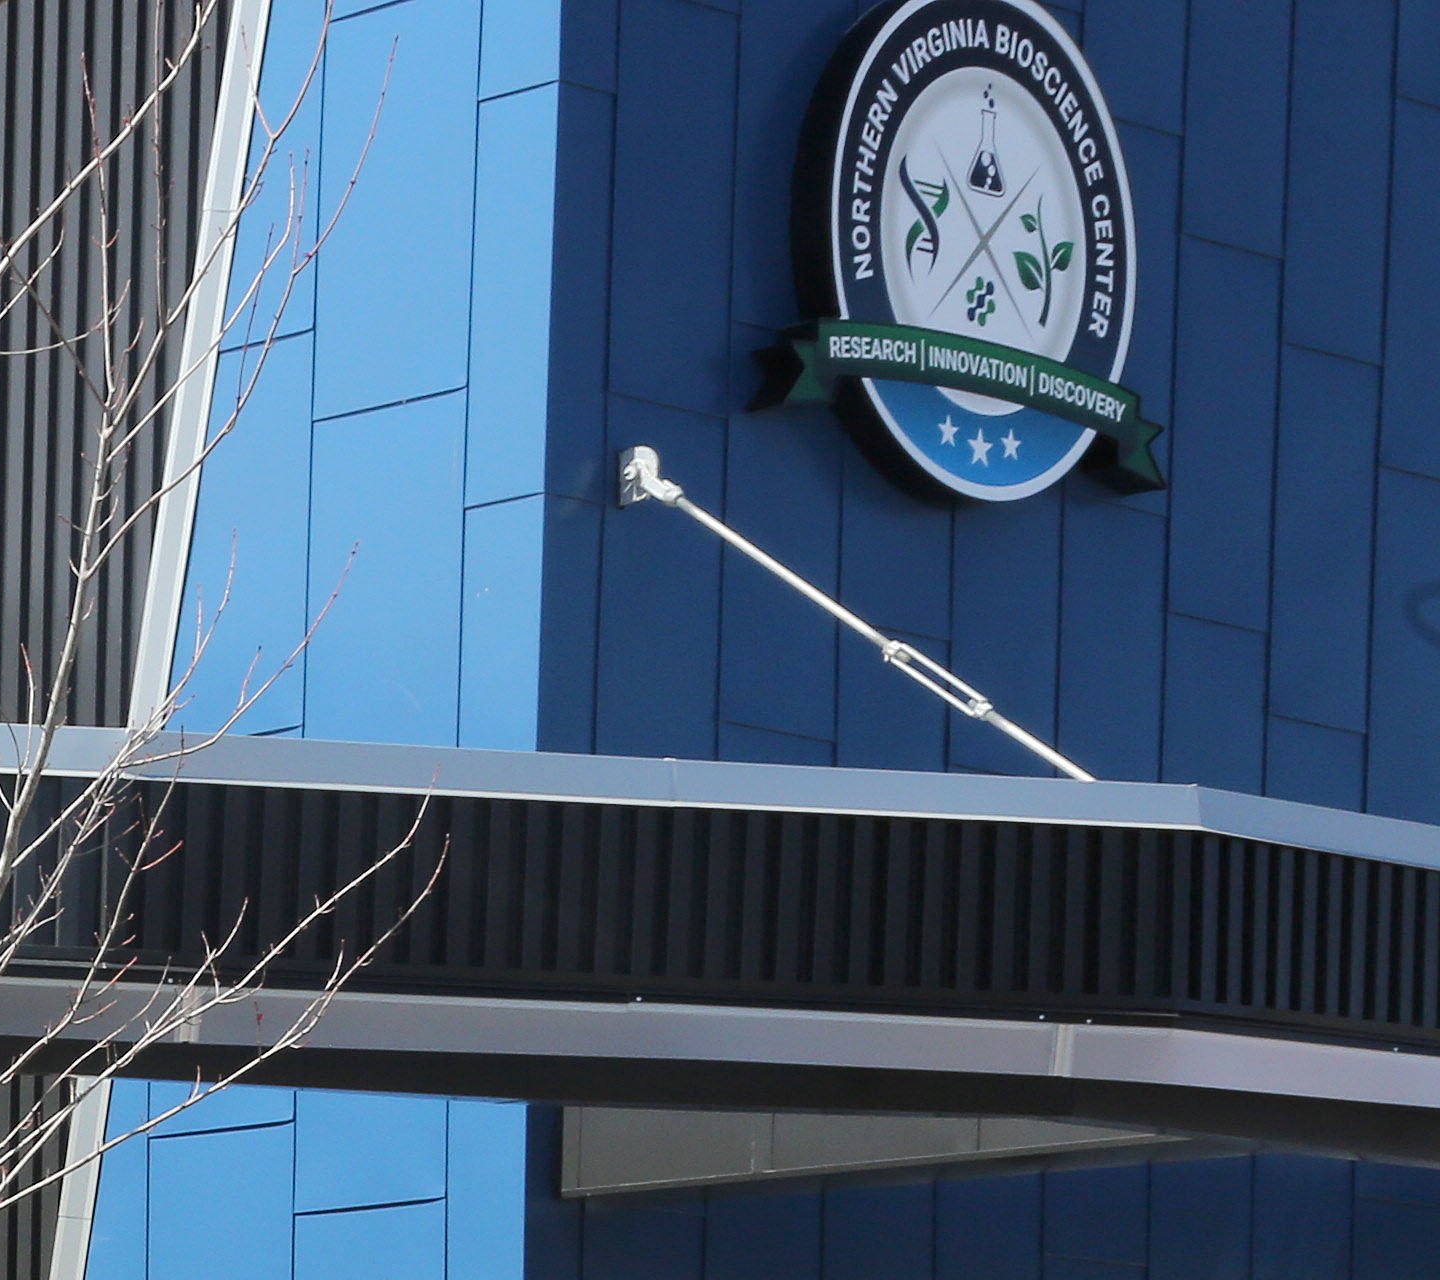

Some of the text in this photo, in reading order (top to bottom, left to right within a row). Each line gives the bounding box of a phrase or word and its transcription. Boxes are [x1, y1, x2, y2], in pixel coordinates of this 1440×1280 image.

[852, 19, 1114, 338] NORTHERN VIRGINIA BIOSCIENCE CENTER
[829, 335, 1126, 422] RESEARCH INNOVATION DISCOVERY
